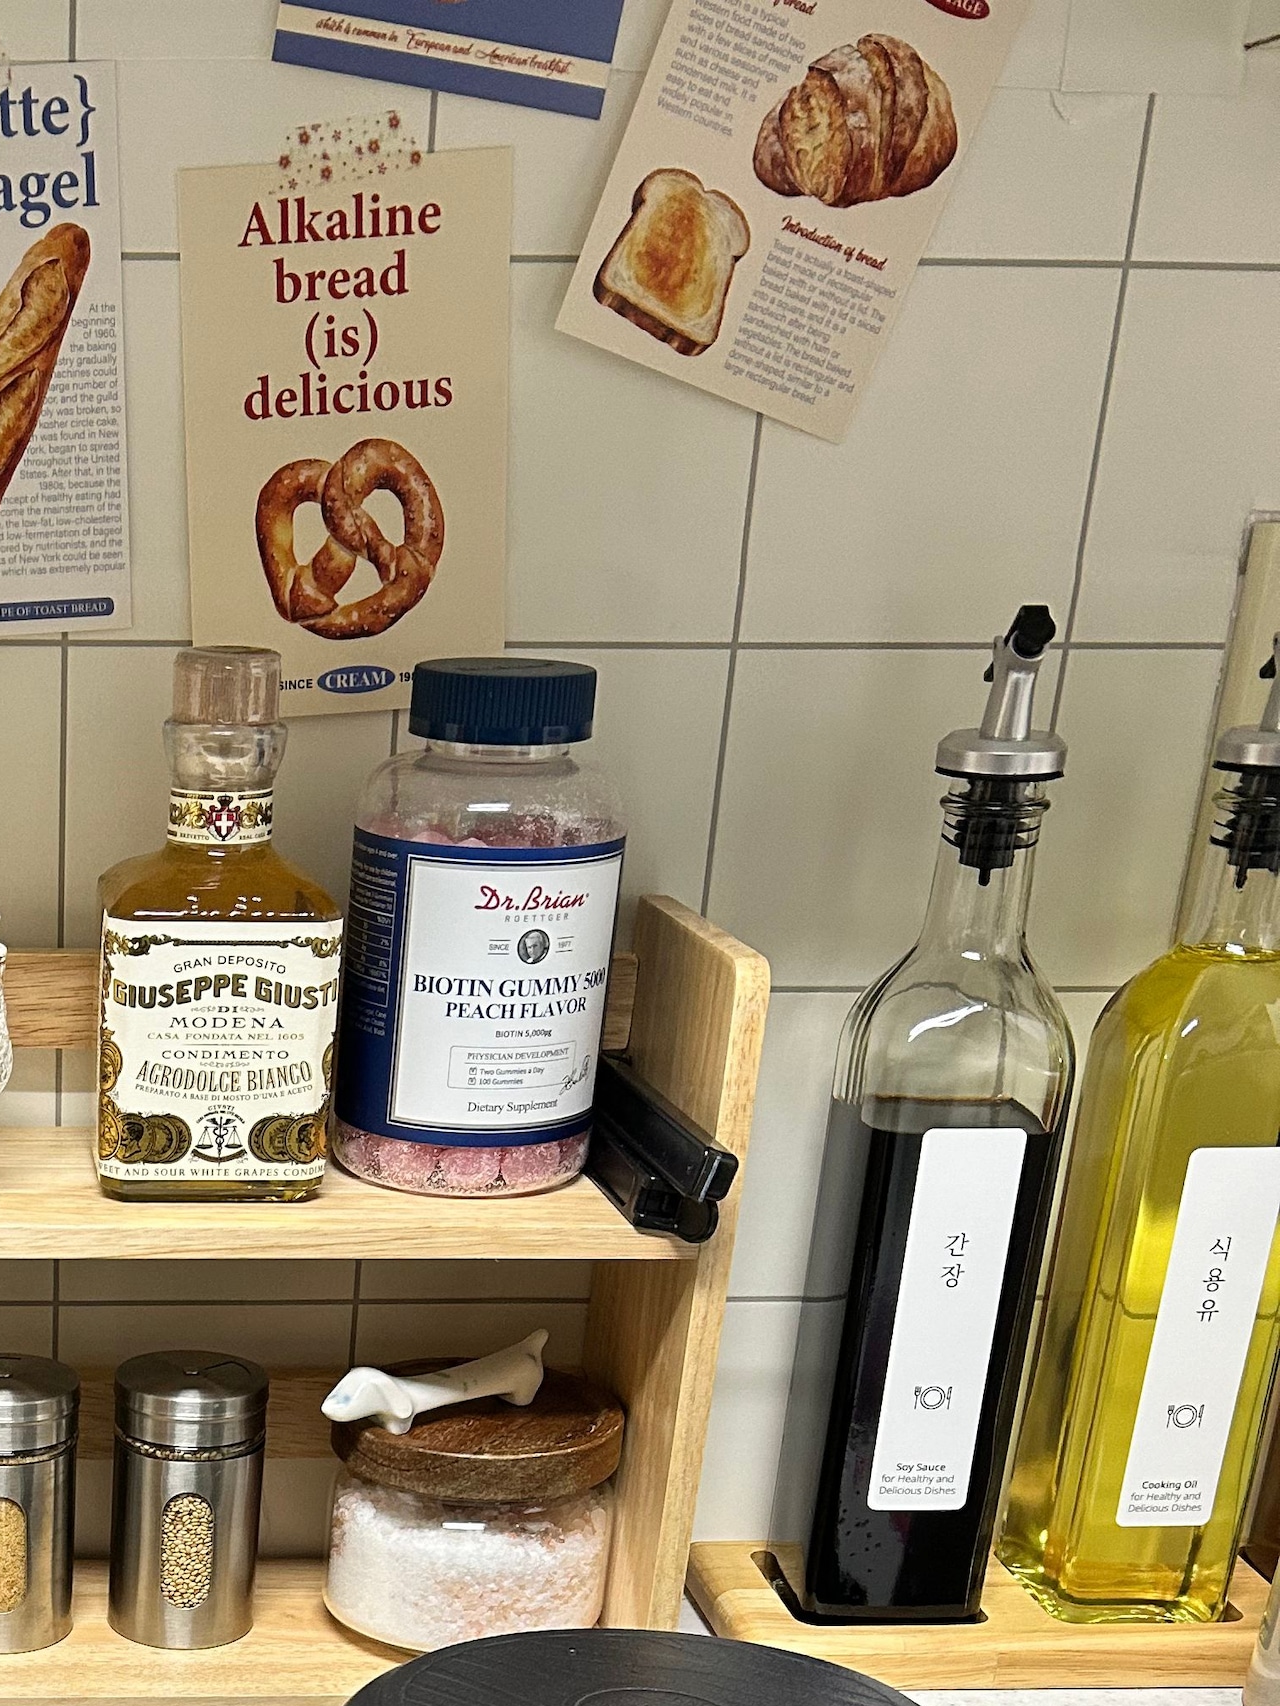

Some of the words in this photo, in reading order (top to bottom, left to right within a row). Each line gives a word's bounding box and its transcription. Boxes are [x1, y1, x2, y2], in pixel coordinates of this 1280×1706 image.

[406, 28, 451, 54] European
[452, 43, 474, 55] and
[475, 47, 528, 66] American
[237, 192, 442, 247] Alkaline
[781, 215, 843, 253] Introduction
[843, 246, 855, 262] of
[855, 248, 888, 271] bread
[272, 249, 410, 304] bread
[89, 303, 99, 313] At
[100, 302, 115, 313] the
[71, 316, 115, 329] beginning
[83, 329, 92, 340] of
[304, 307, 378, 370] (is)
[70, 342, 85, 353] the
[87, 341, 116, 353] baking
[243, 369, 454, 421] delicious
[16, 606, 32, 617] OF
[32, 603, 69, 616] TOAST
[71, 601, 107, 614] BREAD
[279, 679, 314, 691] SINCE
[324, 670, 387, 689] CREAM
[504, 913, 569, 923] ROETTGER
[488, 943, 509, 951] SINCE
[174, 956, 212, 973] GRAN
[217, 955, 286, 975] DEPOSITO
[413, 974, 494, 997] BIOTIN
[499, 974, 582, 997] GUMMY
[583, 967, 606, 990] 5000
[113, 973, 249, 1009] GIUSEPPE
[254, 976, 338, 1010] GIUSTI
[217, 1005, 238, 1013] DI
[445, 1001, 515, 1019] PEACH
[520, 996, 586, 1019] FLAVOR
[169, 1017, 284, 1029] MODENA
[148, 1032, 179, 1040] CASA
[277, 1032, 304, 1040] 1605
[495, 1030, 523, 1038] BIOTIN
[162, 1050, 290, 1059] CONDIMENTO
[467, 1052, 513, 1061] PHYSICIAN
[515, 1047, 569, 1060] DEVELOPMENT
[135, 1060, 241, 1093] AGRODOLCE
[247, 1060, 313, 1092] BIANCO
[480, 1067, 494, 1075] Two
[496, 1067, 527, 1075] Gummies
[533, 1066, 545, 1075] Day
[492, 1078, 523, 1086] Gummies
[135, 1083, 180, 1098] PREPARATO
[190, 1093, 208, 1101] BASE
[222, 1094, 251, 1102] MOSTO
[287, 1084, 313, 1095] ACETO
[467, 1101, 504, 1115] Dietary
[506, 1098, 558, 1114] Supplement
[124, 1168, 149, 1176] AND
[154, 1168, 186, 1177] SOUR
[190, 1168, 230, 1177] WHITE
[234, 1168, 279, 1177] GRAPES
[283, 1164, 325, 1177] CONDIM
[939, 1232, 970, 1289] 간장
[1195, 1236, 1232, 1322] 식용유
[896, 1462, 914, 1473] Soy
[916, 1463, 946, 1472] Sauce
[881, 1474, 895, 1483] for
[898, 1474, 934, 1485] Healthy
[936, 1474, 954, 1483] and
[1142, 1480, 1181, 1491] Cooking
[1184, 1480, 1198, 1489] Oil
[879, 1486, 922, 1495] Delicious
[924, 1486, 956, 1495] Dishes
[1130, 1492, 1144, 1501] for
[1146, 1492, 1181, 1502] Healthy
[1183, 1492, 1201, 1501] and
[1128, 1504, 1169, 1512] Delicious
[1171, 1503, 1202, 1512] Dishes
